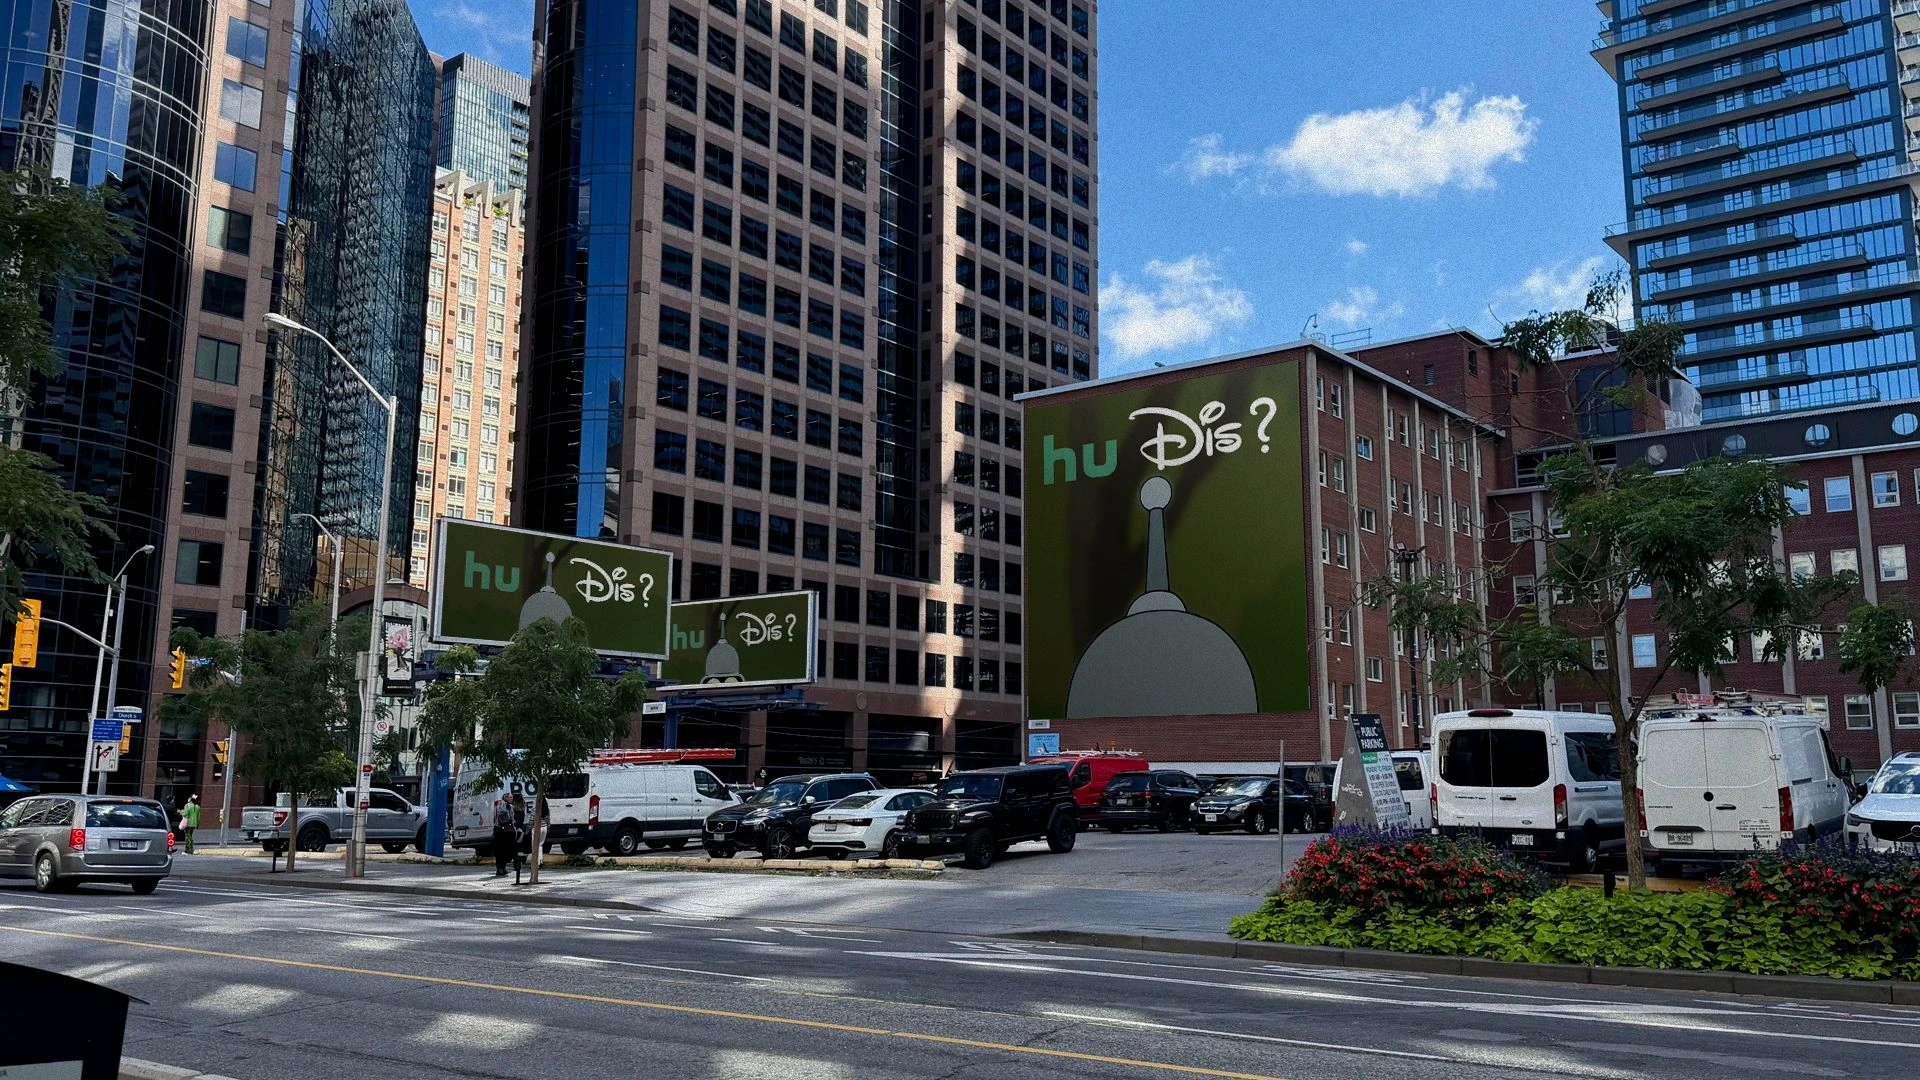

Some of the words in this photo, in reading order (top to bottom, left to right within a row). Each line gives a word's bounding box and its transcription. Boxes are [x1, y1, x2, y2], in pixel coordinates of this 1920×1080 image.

[1043, 434, 1118, 486] hu
[464, 550, 520, 593] hu
[672, 623, 705, 650] hu
[1360, 726, 1378, 737] PUBLIC
[1361, 739, 1384, 749] PARKING
